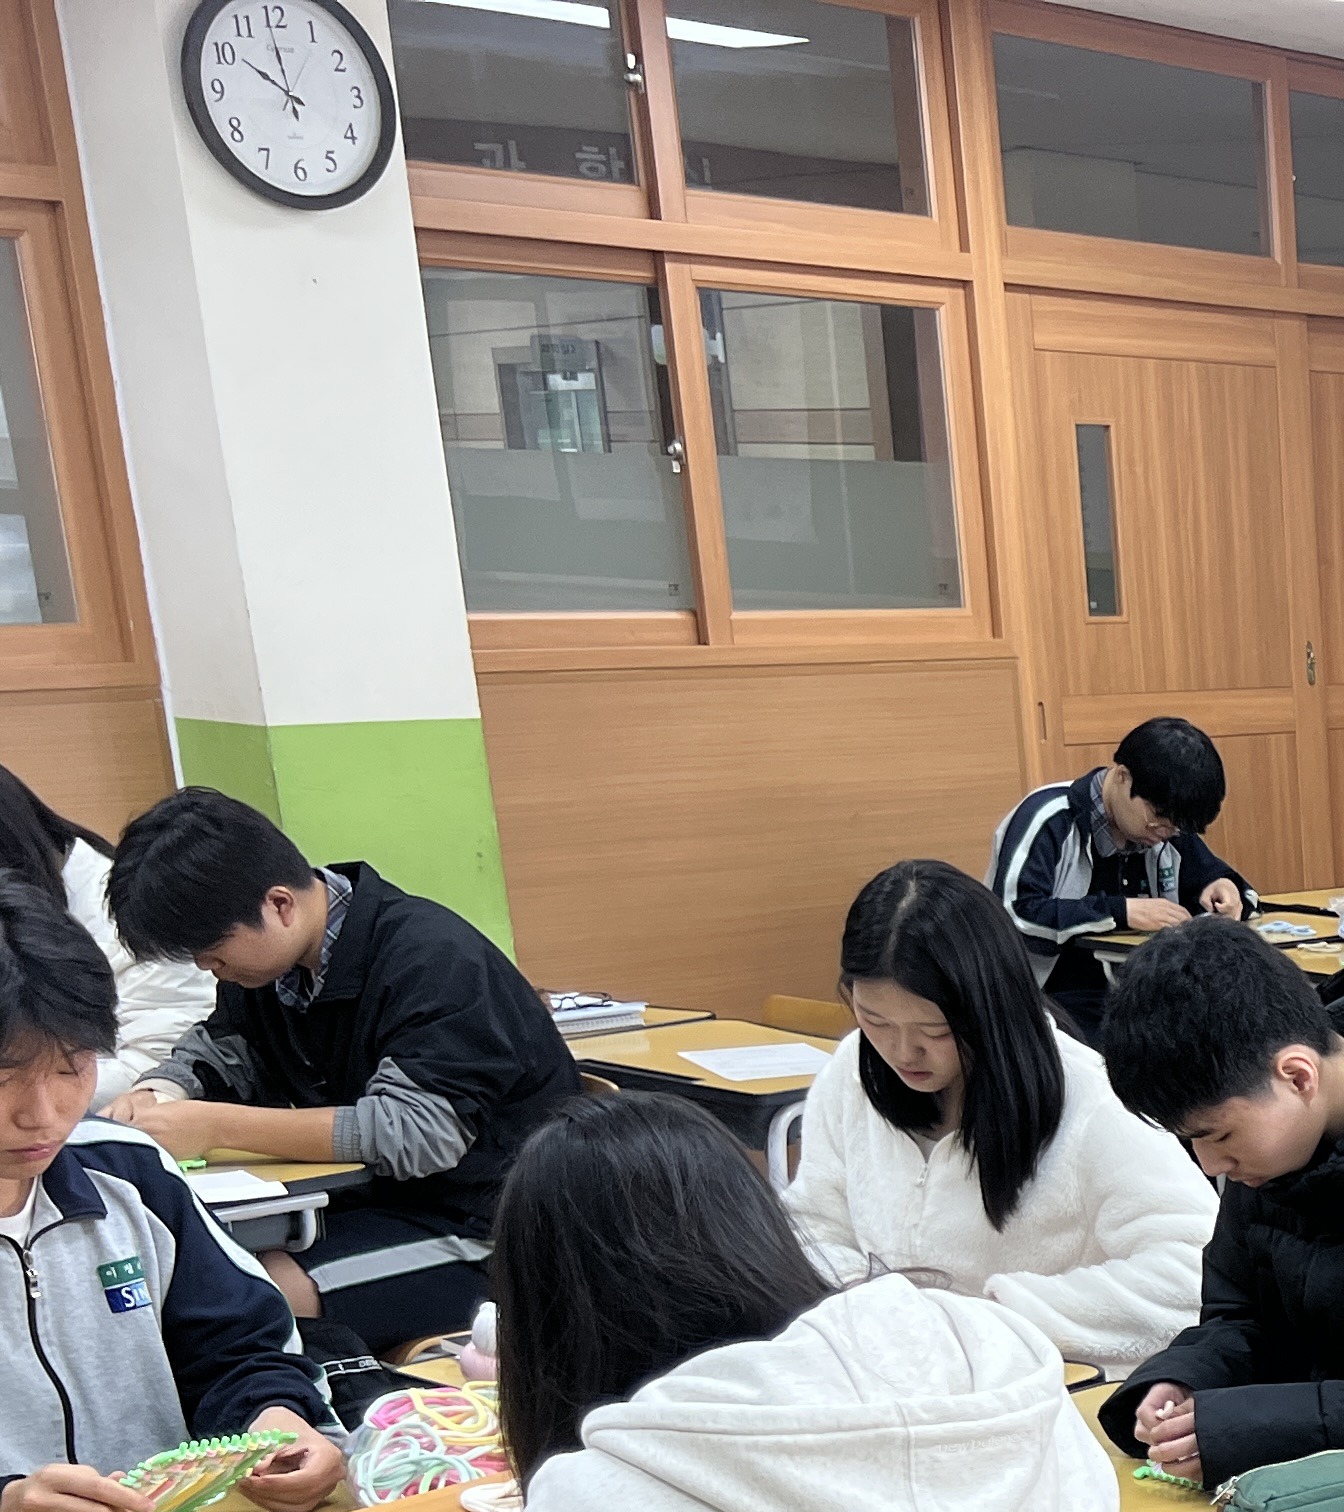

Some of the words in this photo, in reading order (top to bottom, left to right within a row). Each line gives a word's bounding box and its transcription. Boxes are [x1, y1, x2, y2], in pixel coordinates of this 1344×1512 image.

[232, 14, 255, 38] 11
[262, 5, 288, 29] 12
[307, 20, 318, 43] 1
[213, 41, 236, 66] 10
[331, 49, 347, 73] 2
[211, 78, 225, 102] 9
[350, 86, 364, 109] 3
[228, 116, 244, 143] 8
[343, 122, 357, 145] 4
[257, 147, 270, 170] 7
[324, 150, 337, 173] 5
[293, 159, 307, 182] 6
